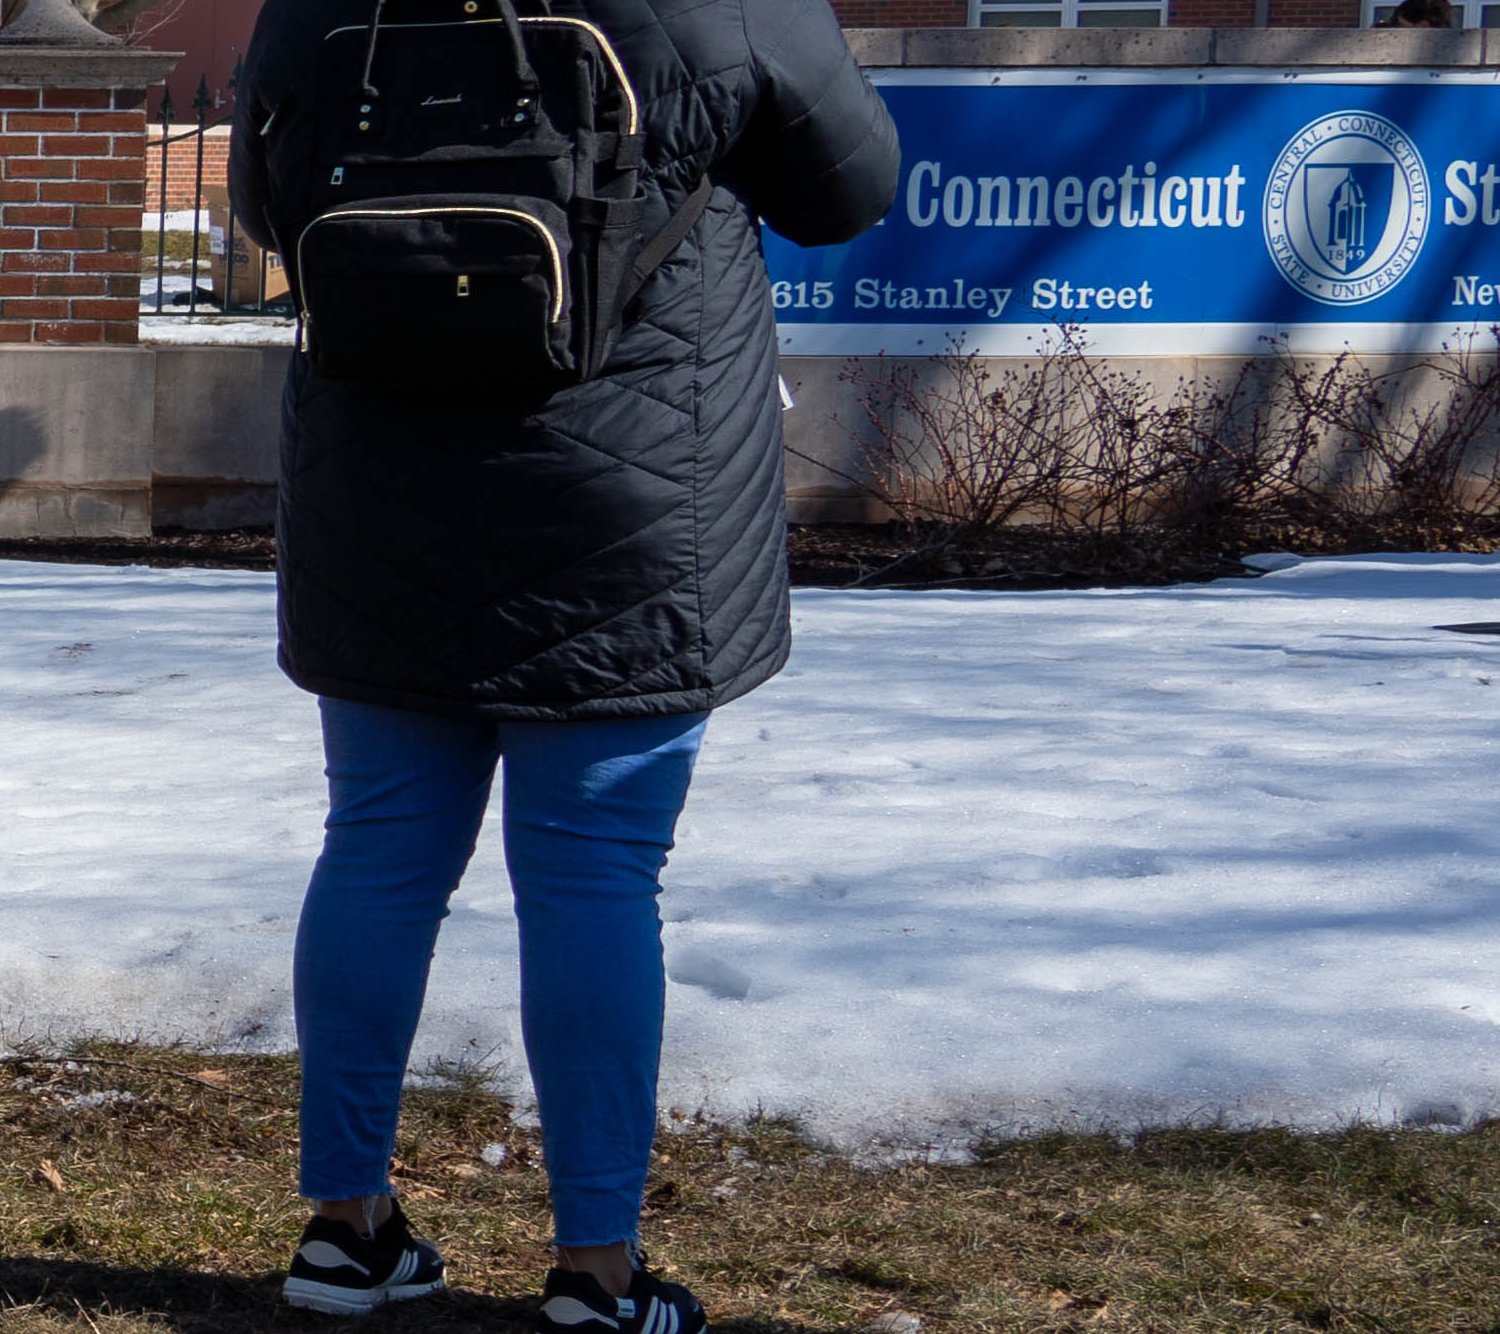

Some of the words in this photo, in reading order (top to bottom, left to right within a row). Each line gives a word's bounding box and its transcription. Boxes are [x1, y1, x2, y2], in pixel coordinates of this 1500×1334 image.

[906, 160, 1247, 229] Connecticut
[1270, 129, 1323, 210] CENTRAL
[1338, 117, 1425, 209] CONNECTICUT
[1272, 233, 1310, 284] STATE
[1331, 230, 1421, 299] UNIVERSITY
[1327, 248, 1366, 261] 1849
[854, 278, 1012, 318] Stanley
[1032, 278, 1154, 310] Street
